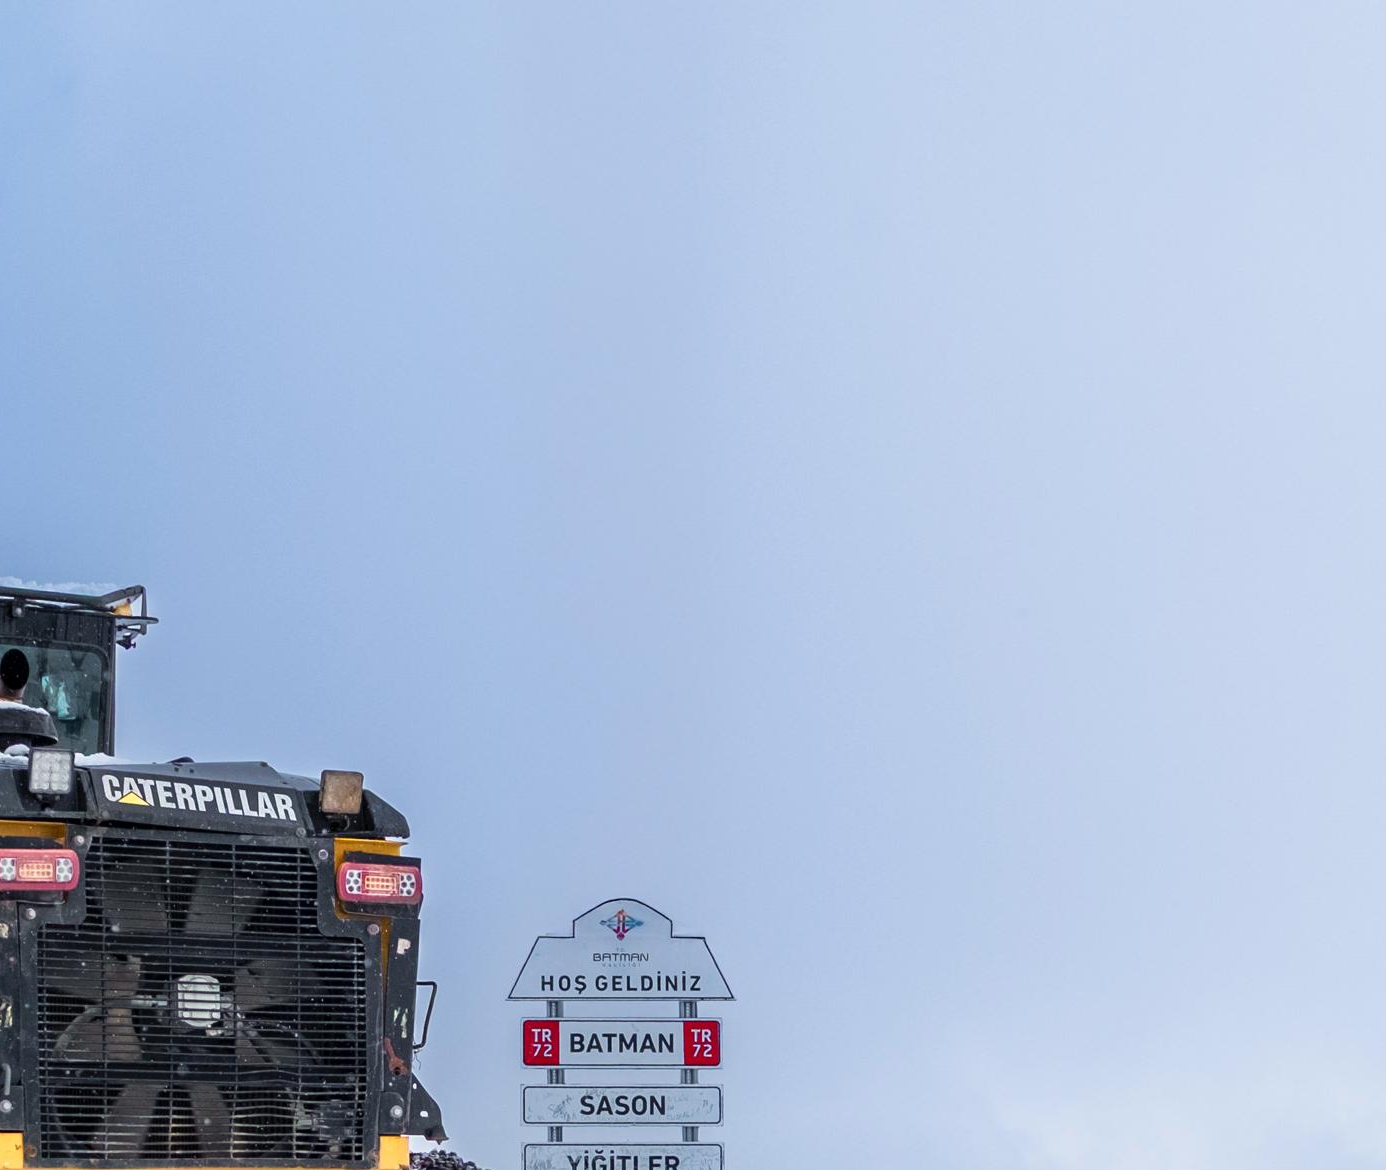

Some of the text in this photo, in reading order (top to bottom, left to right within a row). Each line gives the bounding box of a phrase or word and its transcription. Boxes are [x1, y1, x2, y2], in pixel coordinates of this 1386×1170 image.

[102, 774, 297, 822] CATERPILLAR
[593, 952, 649, 962] BATMAN
[541, 969, 701, 995] HOŞ GELDİNİZ
[531, 1028, 552, 1043] TR
[569, 1032, 674, 1053] BATMAN
[691, 1029, 712, 1043] TR
[532, 1044, 553, 1057] 72
[692, 1045, 713, 1058] 72
[580, 1095, 666, 1116] SASON
